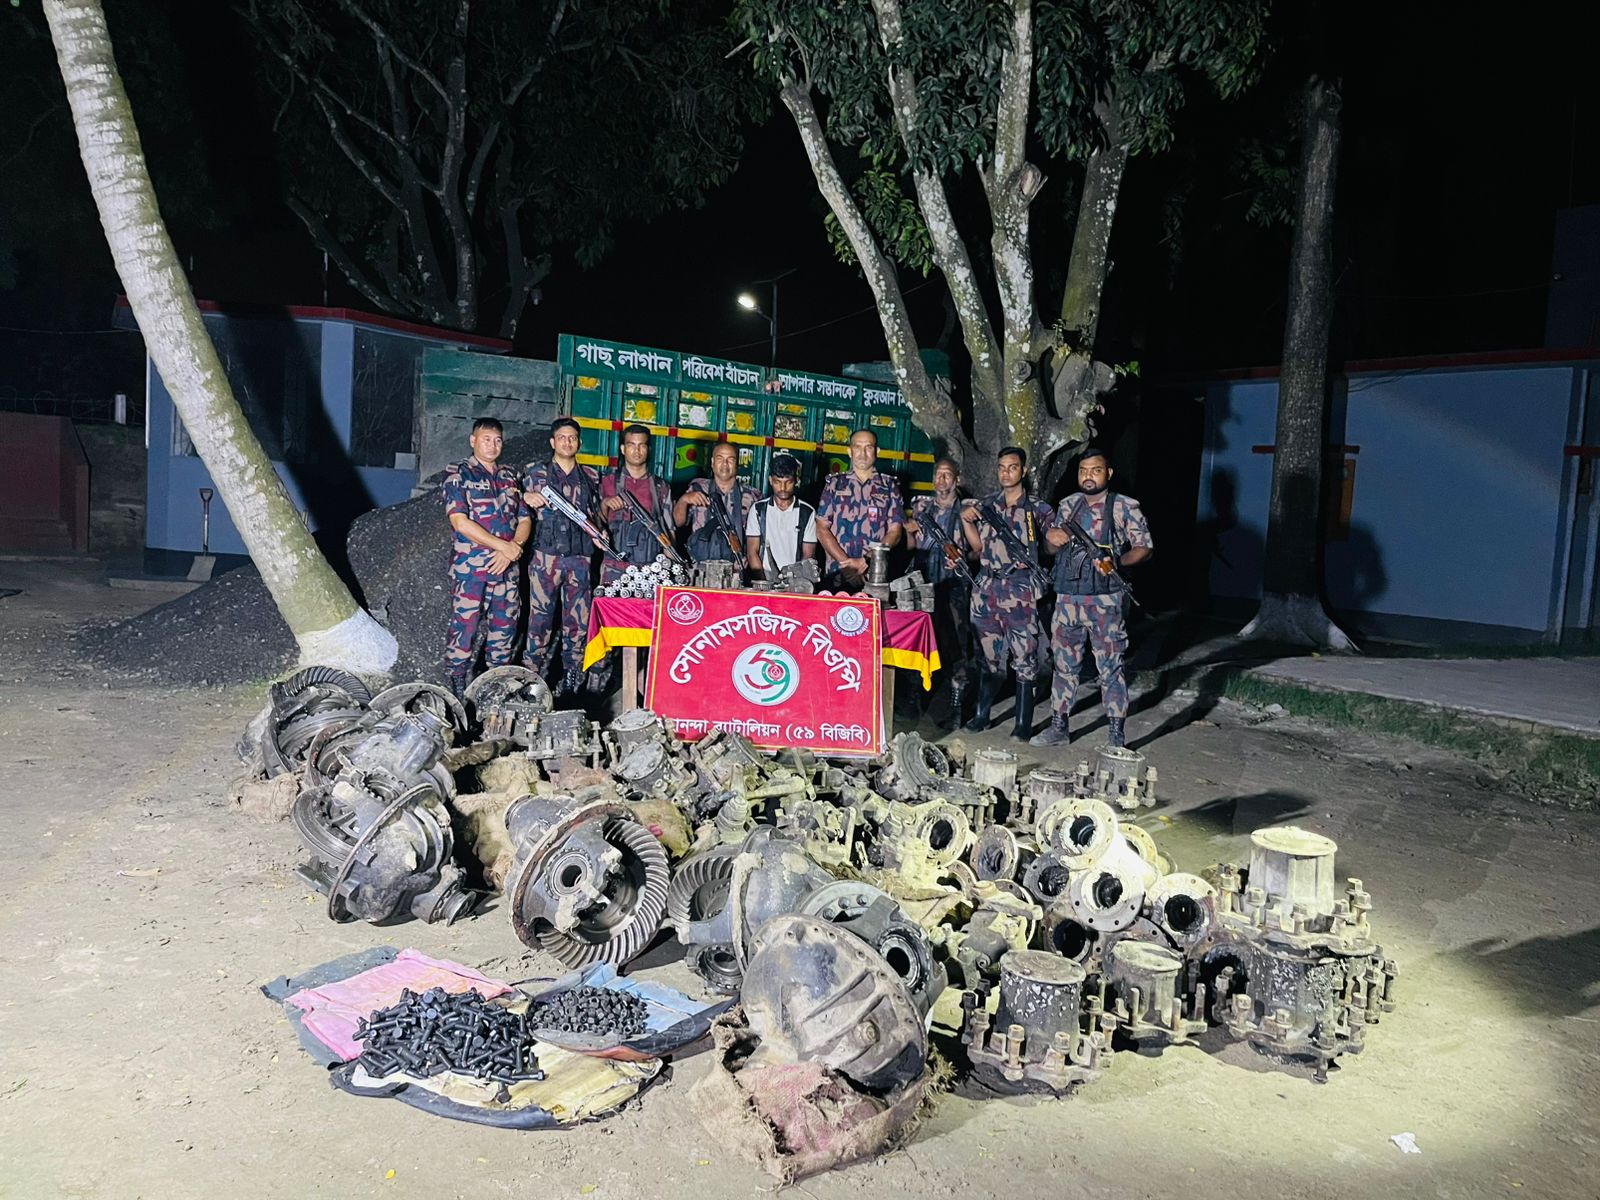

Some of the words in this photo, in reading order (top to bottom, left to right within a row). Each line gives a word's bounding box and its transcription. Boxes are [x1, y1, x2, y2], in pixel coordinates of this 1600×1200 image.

[576, 343, 616, 370] গাছ
[618, 350, 673, 374] লাগান
[682, 357, 723, 380] পরিবেশ
[725, 362, 760, 386] বাঁচান
[778, 373, 815, 394] আপনার
[817, 380, 858, 400] সন্তানকে
[862, 387, 897, 407] কুরআন
[669, 606, 802, 684] সোনামসজিদ
[802, 623, 862, 693] বিওপি
[656, 718, 708, 733] মানন্দা
[785, 723, 815, 743] (৫৯
[820, 723, 872, 746] বিজিবি)
